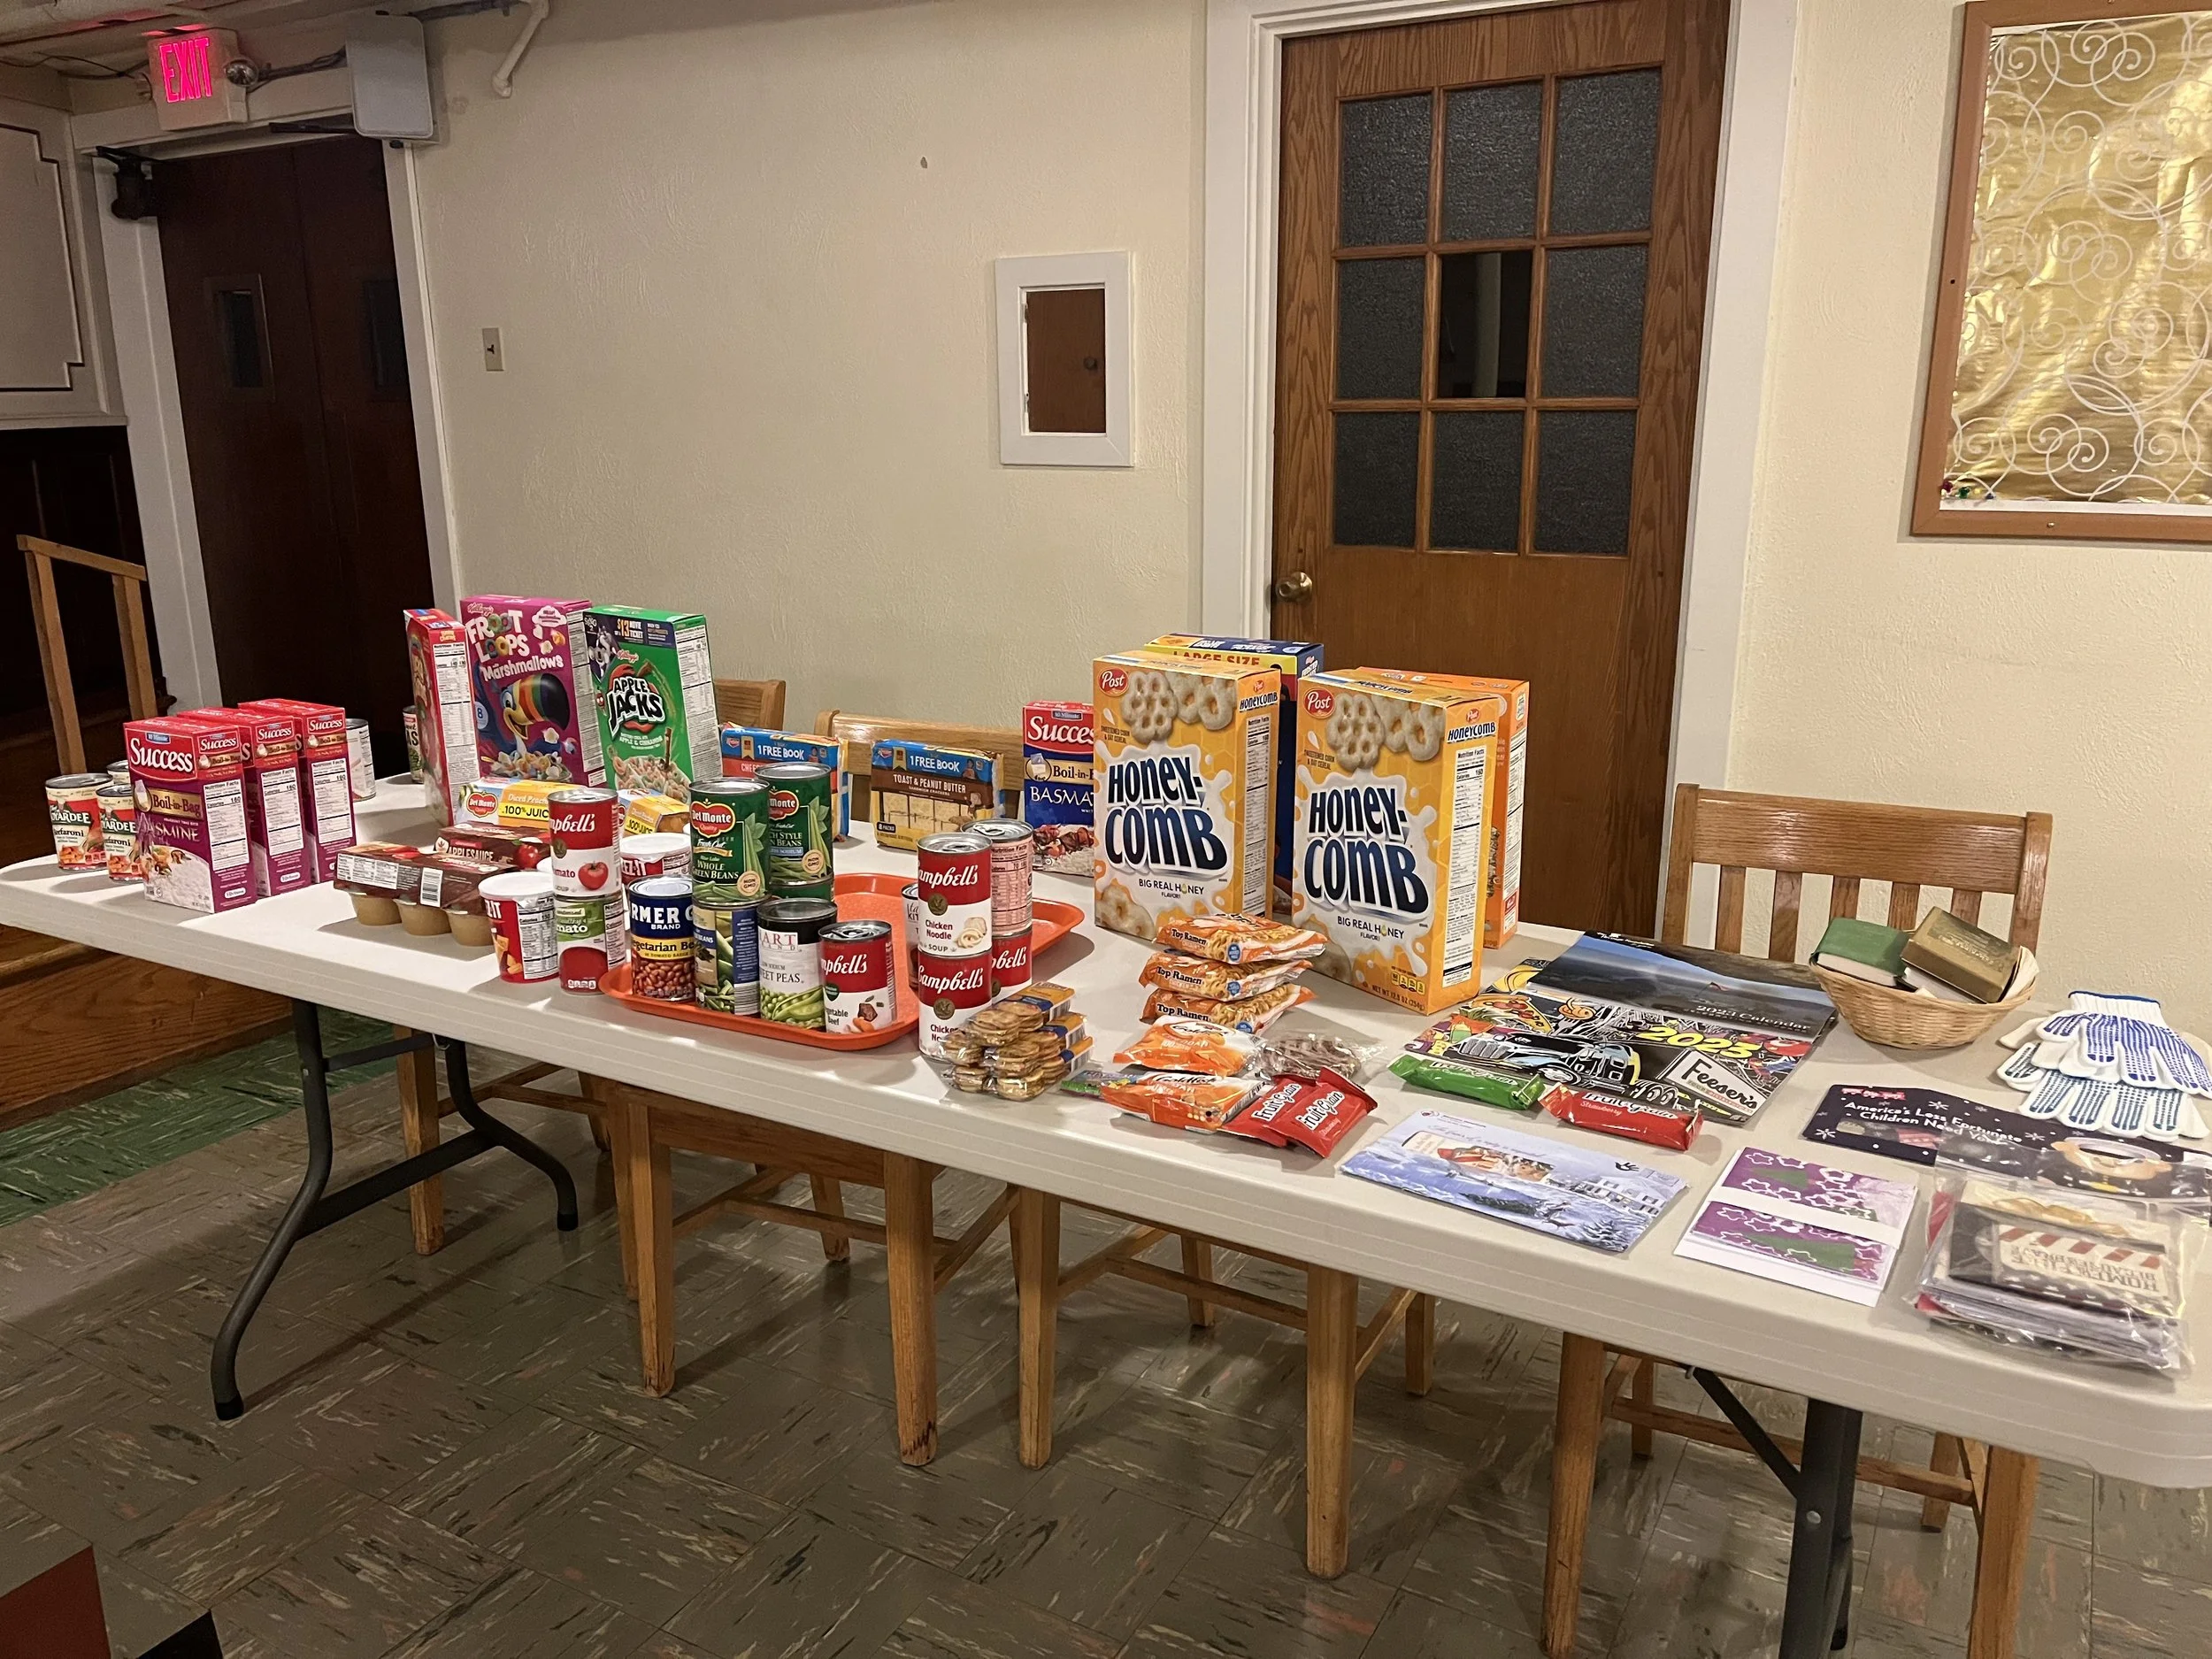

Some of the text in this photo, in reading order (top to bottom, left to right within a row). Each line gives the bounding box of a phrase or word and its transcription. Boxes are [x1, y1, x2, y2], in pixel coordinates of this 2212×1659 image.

[159, 38, 211, 103] EXIT
[465, 610, 523, 644] FROOT
[475, 634, 531, 663] LOOPS
[480, 655, 564, 681] Marshmallows
[1226, 655, 1260, 665] SIZE
[614, 678, 648, 693] APPLE
[1102, 671, 1125, 689] Post
[1240, 692, 1278, 710] HONEYCOMB
[1308, 692, 1332, 710] Post
[608, 693, 664, 733] JACKS
[310, 717, 342, 732] Success
[1448, 722, 1495, 741] HONEYCOMB
[257, 727, 292, 741] Success
[200, 737, 236, 751] Success
[757, 745, 804, 760] 1 FREE BOOK
[130, 738, 193, 772] Success
[910, 756, 960, 772] 1 FREE BOOK
[893, 774, 913, 785] TOAST
[919, 778, 942, 789] PEANUT
[943, 782, 966, 794] BUTTER
[508, 794, 526, 803] Diced
[1030, 786, 1093, 806] BASMA
[153, 795, 201, 817] Boil-in-Bag
[526, 808, 549, 818] JUIC
[549, 814, 595, 834] mpbell's
[692, 810, 732, 823] Del Monte
[697, 838, 711, 847] Fresh
[1105, 807, 1228, 871] COMB
[447, 846, 494, 862] APPLESAUCE
[697, 860, 725, 870] WHOLE
[710, 871, 739, 879] BEANS
[918, 864, 978, 888] ampbell's
[1304, 840, 1429, 913] COMB
[1139, 879, 1204, 895] BIG REAL HONEY
[631, 903, 680, 924] RMER
[926, 920, 953, 930] Chicken
[1337, 916, 1405, 940] BIG REAL HONEY
[926, 930, 952, 940] Noodle
[1172, 929, 1207, 945] Top Ramen
[821, 954, 868, 976] mpbell's
[776, 972, 801, 983] PEAS
[1157, 966, 1202, 985] Top Ramen
[1372, 985, 1381, 995] NET
[1157, 1004, 1209, 1022] Top Ramen
[1696, 1005, 1736, 1017] 2023
[1740, 1013, 1810, 1030] Calendar
[1637, 1025, 1762, 1058] 2023
[1155, 1076, 1217, 1085] Goldfish
[1682, 1058, 1758, 1110] Feeser's
[1580, 1101, 1622, 1117] Strawberry
[1844, 1102, 2023, 1142] America's Less Fortunate
[1860, 1111, 1963, 1135] Children Need
